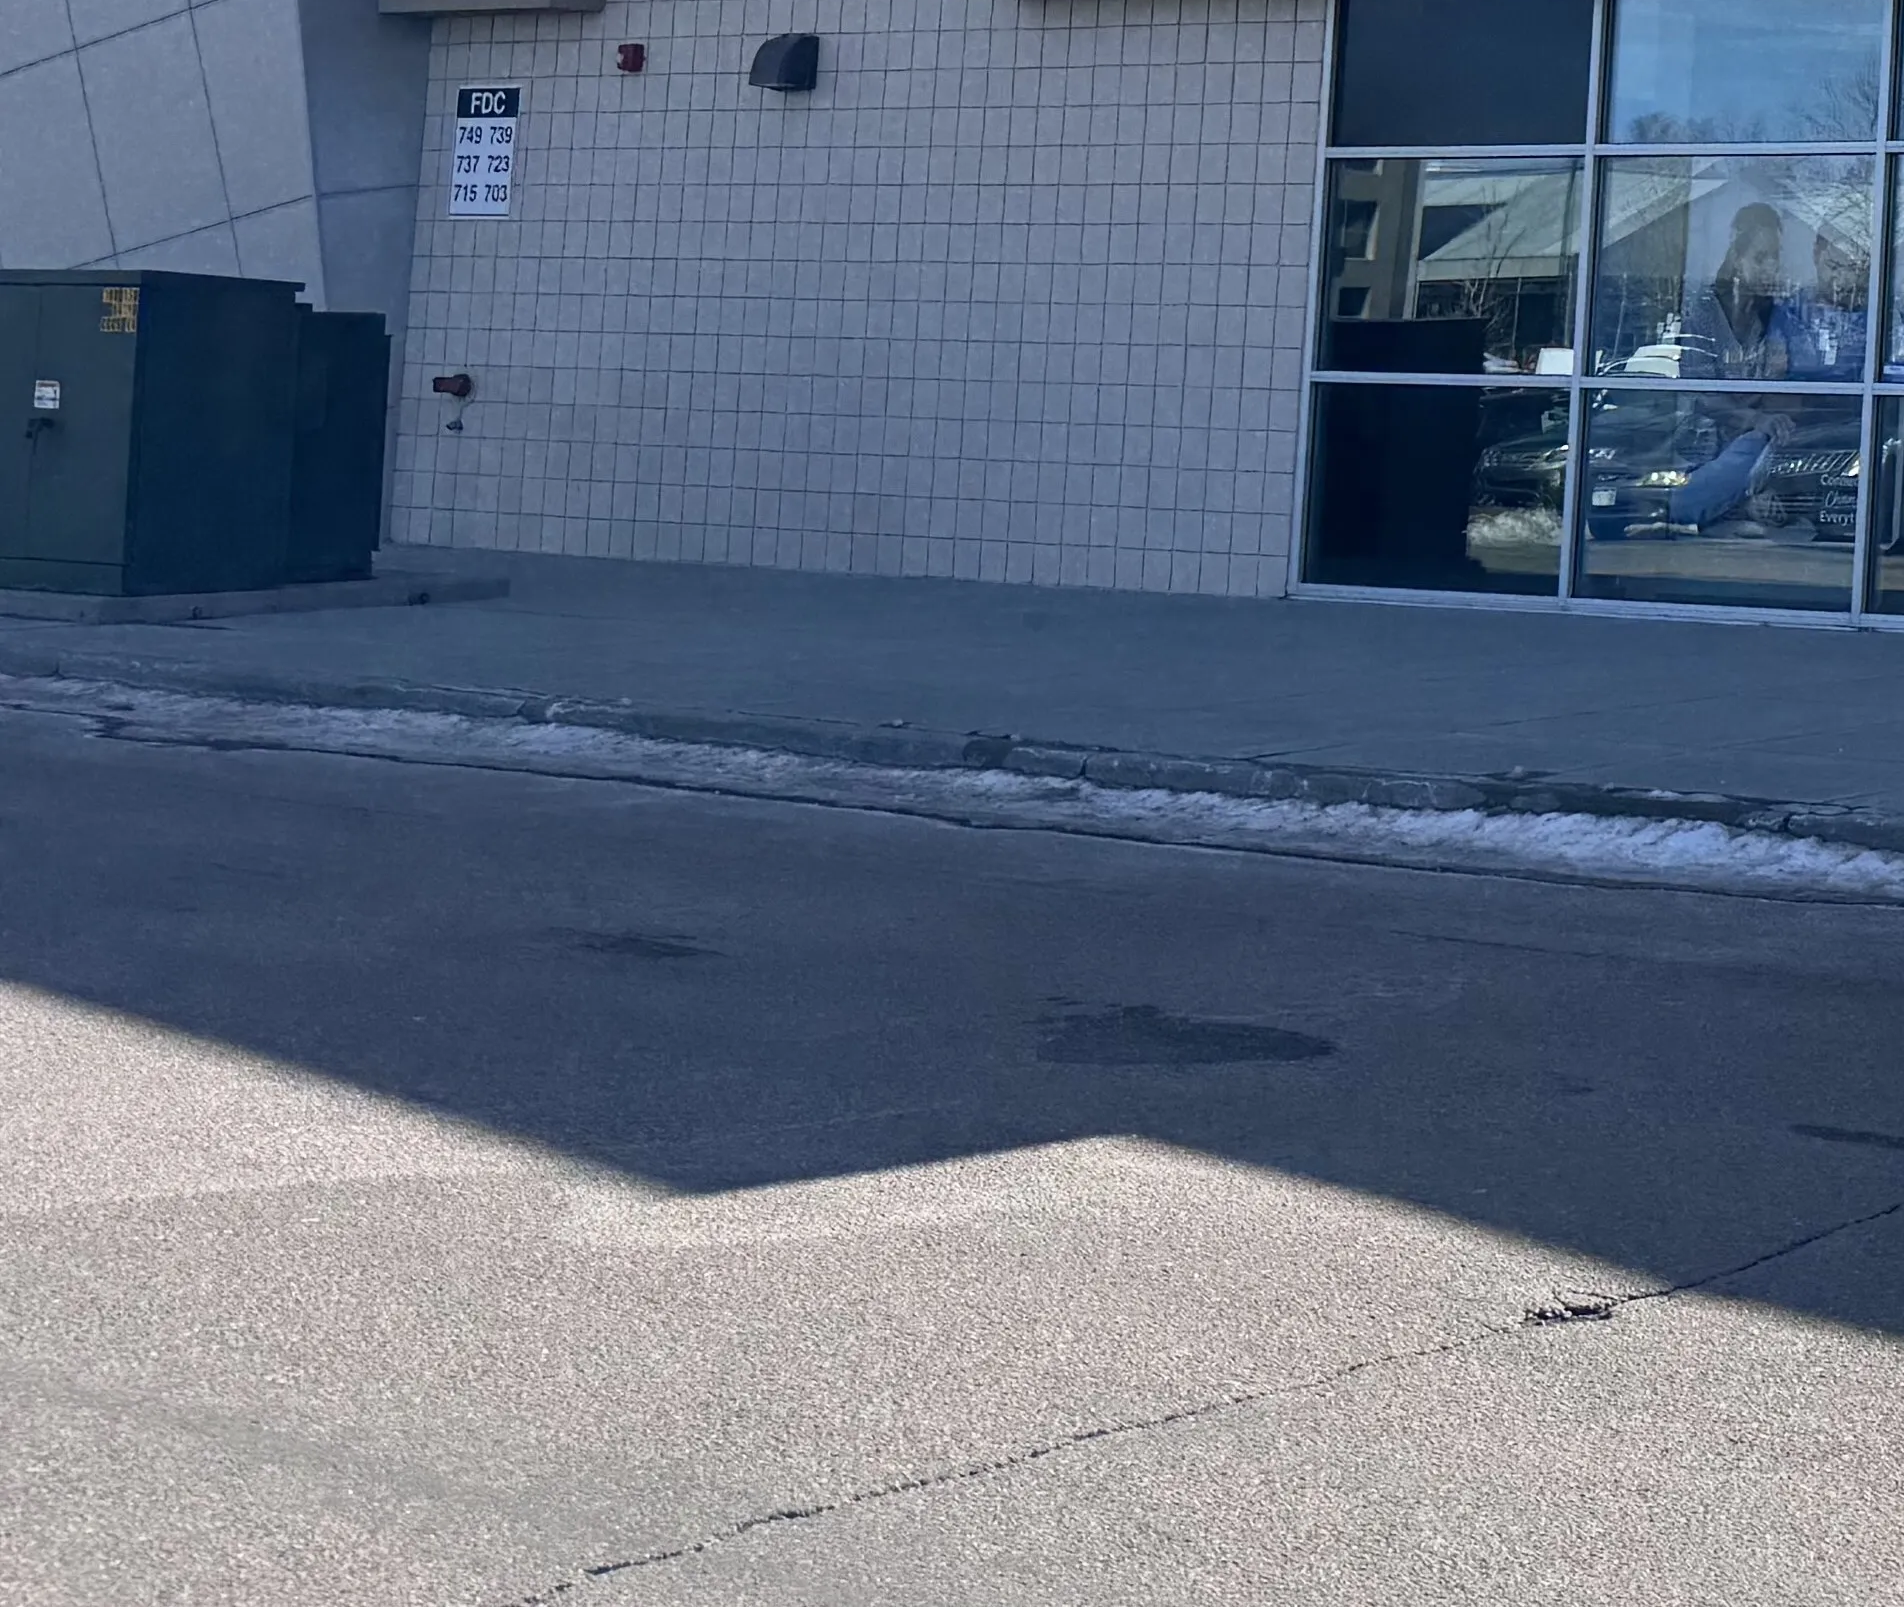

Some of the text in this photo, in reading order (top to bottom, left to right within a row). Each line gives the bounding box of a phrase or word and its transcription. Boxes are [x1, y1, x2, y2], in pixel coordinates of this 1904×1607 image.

[470, 91, 506, 114] FDC
[458, 126, 513, 144] 749 739
[456, 155, 510, 173] 737 723
[454, 184, 508, 203] 715 703
